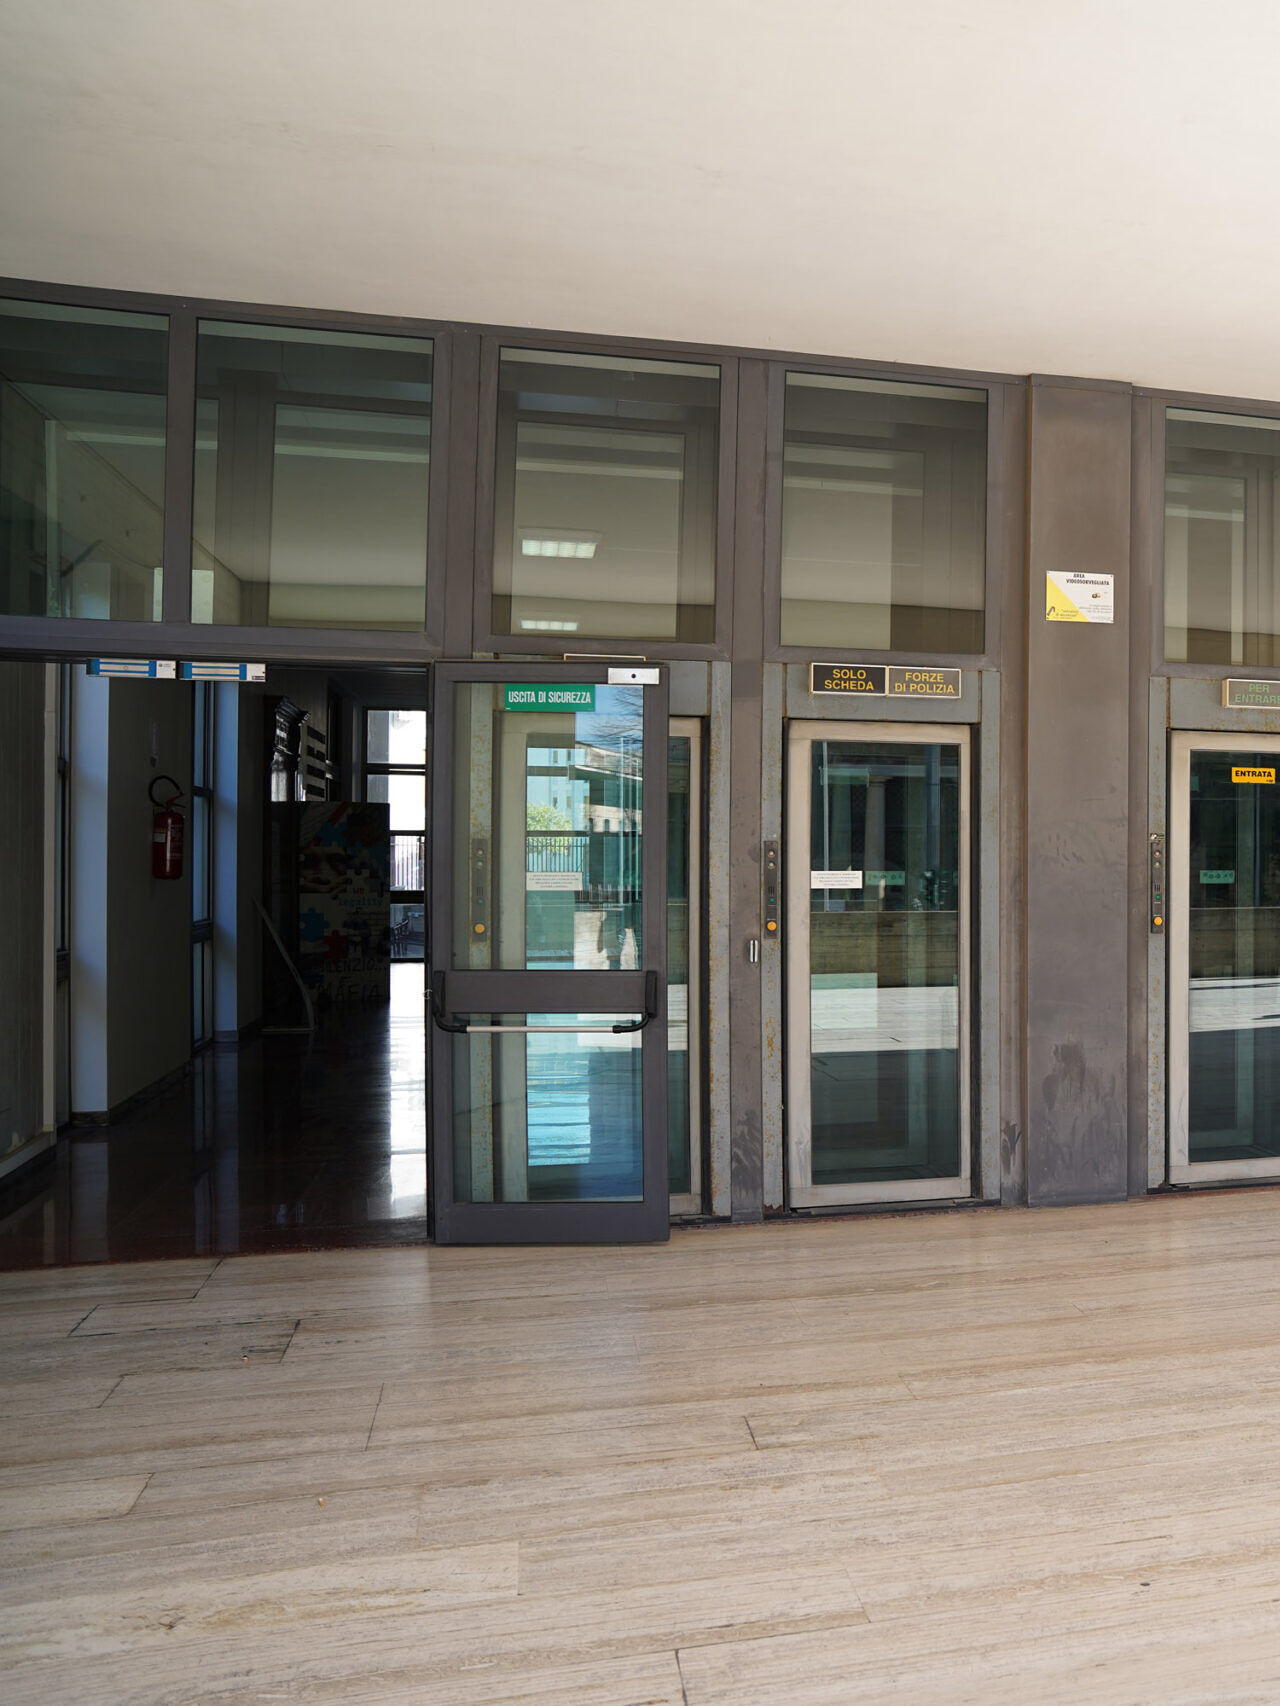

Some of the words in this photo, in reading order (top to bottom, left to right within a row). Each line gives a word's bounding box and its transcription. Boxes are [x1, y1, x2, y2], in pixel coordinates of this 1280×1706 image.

[832, 669, 867, 680] SOLO
[905, 672, 945, 683] FORZE
[824, 680, 874, 691] SCHEDA
[895, 683, 907, 693] DI
[910, 683, 955, 694] POLIZIA
[1248, 684, 1270, 692] PER
[508, 691, 536, 703] USCITA
[538, 692, 546, 703] DI
[548, 692, 591, 703] SICUREZZA
